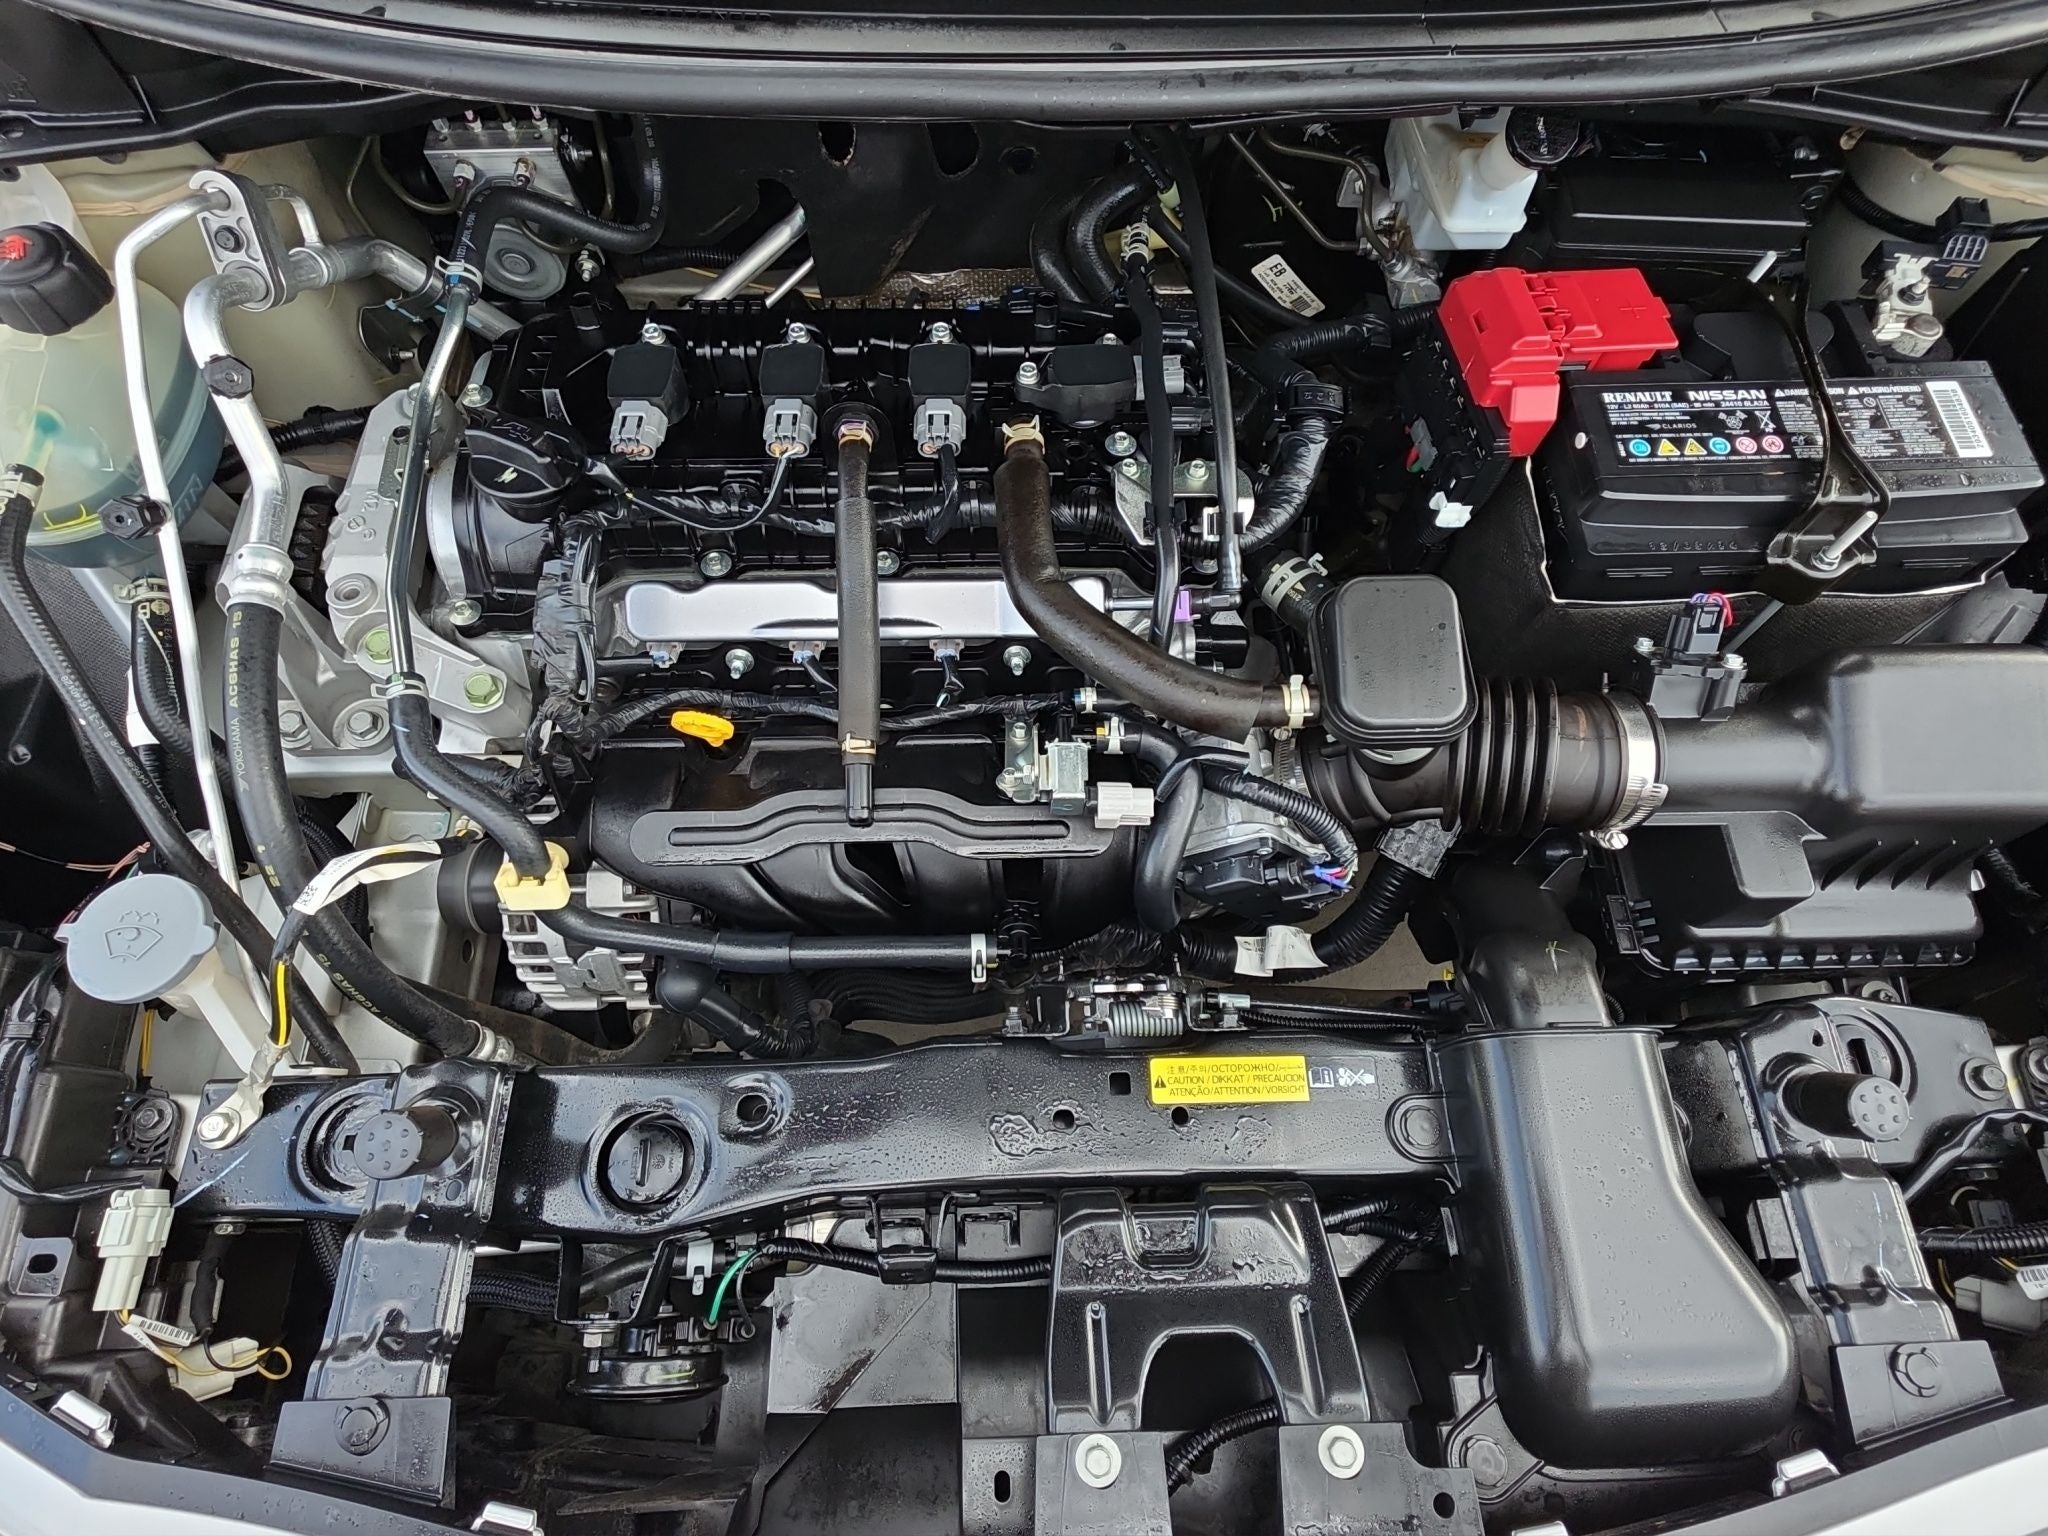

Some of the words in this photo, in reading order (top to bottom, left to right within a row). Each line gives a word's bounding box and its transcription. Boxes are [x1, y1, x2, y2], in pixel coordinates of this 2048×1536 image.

[1269, 262, 1287, 278] EB
[1602, 391, 1673, 403] RENAULT
[1688, 389, 1767, 401] NISSAN
[1662, 422, 1697, 430] CLARIOS
[230, 717, 246, 777] YOKOHAMA
[1167, 1075, 1204, 1085] CAUTION
[1212, 1074, 1244, 1084] DIKKAT
